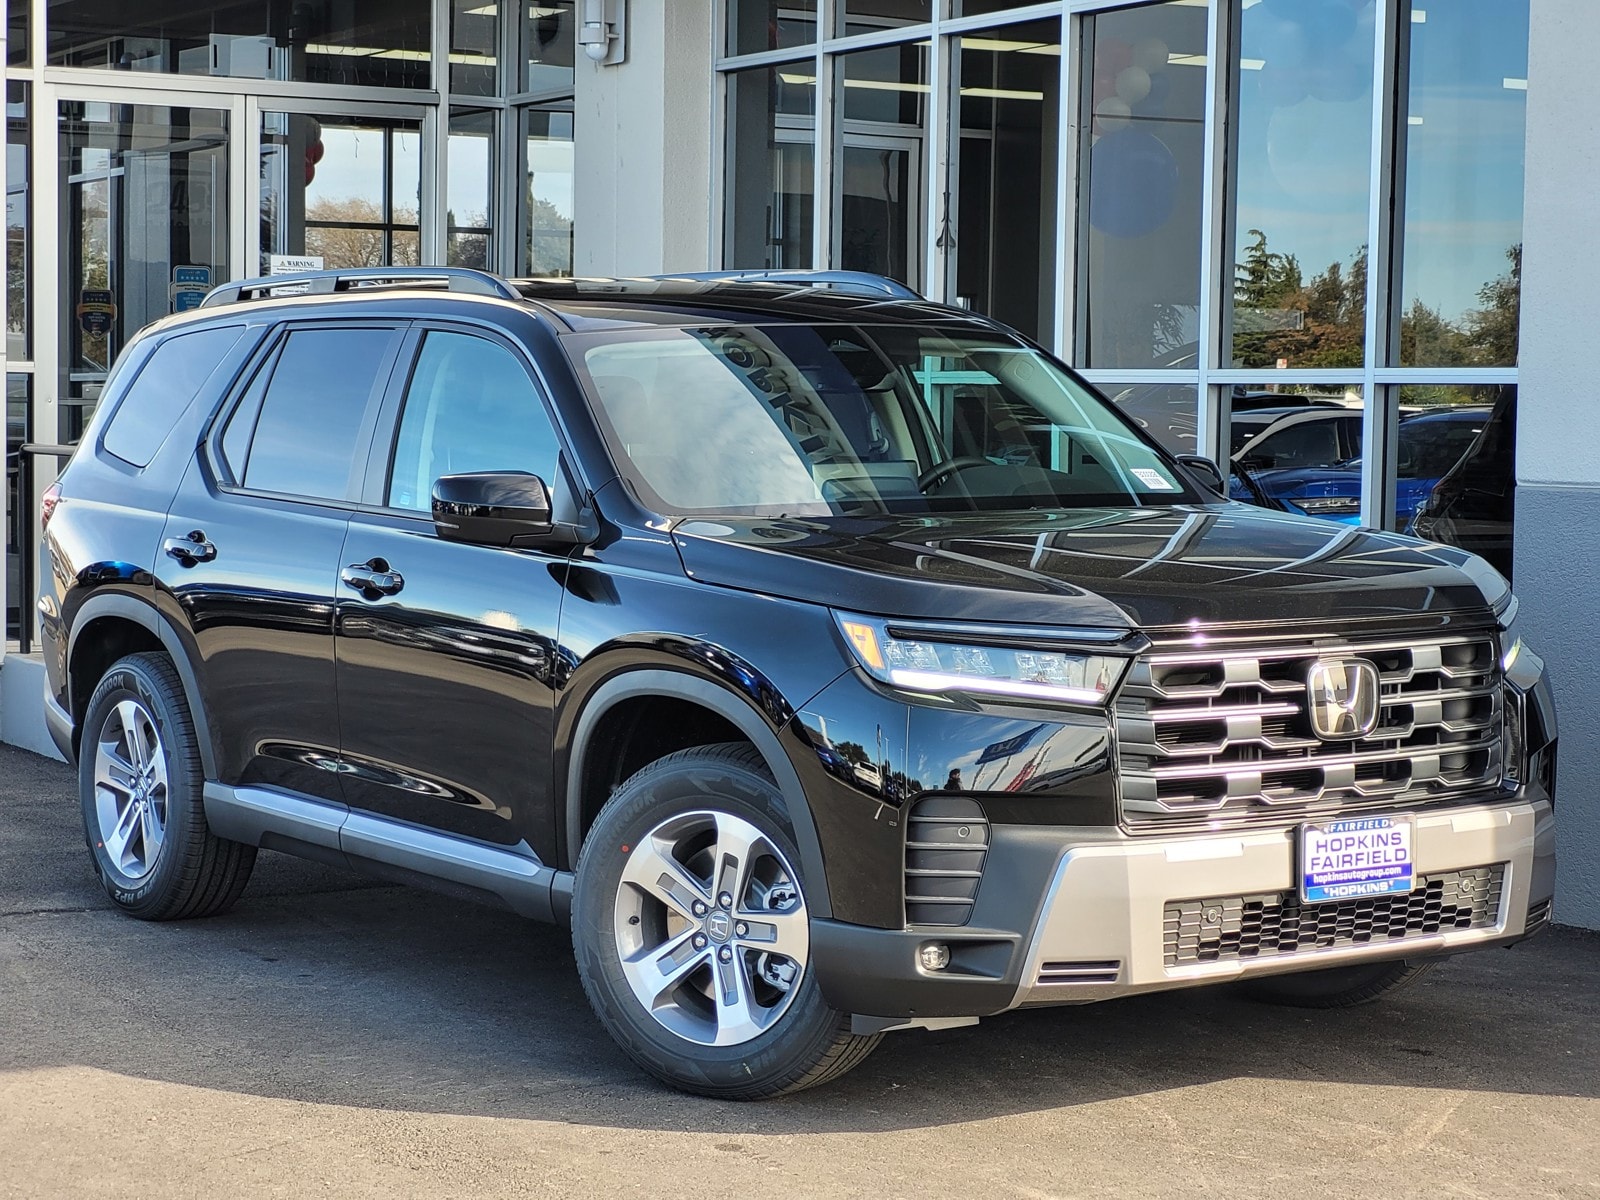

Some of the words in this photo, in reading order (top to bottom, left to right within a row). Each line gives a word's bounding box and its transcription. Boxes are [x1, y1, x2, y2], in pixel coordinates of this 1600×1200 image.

[287, 260, 315, 268] WARNING
[1330, 819, 1389, 833] FAIRFIELD
[1316, 832, 1402, 853] HOPKINS
[1310, 848, 1407, 871] FAIRFIELD
[1313, 866, 1402, 884] hopkinsautogroup.com
[1329, 881, 1389, 897] HOPKINS
